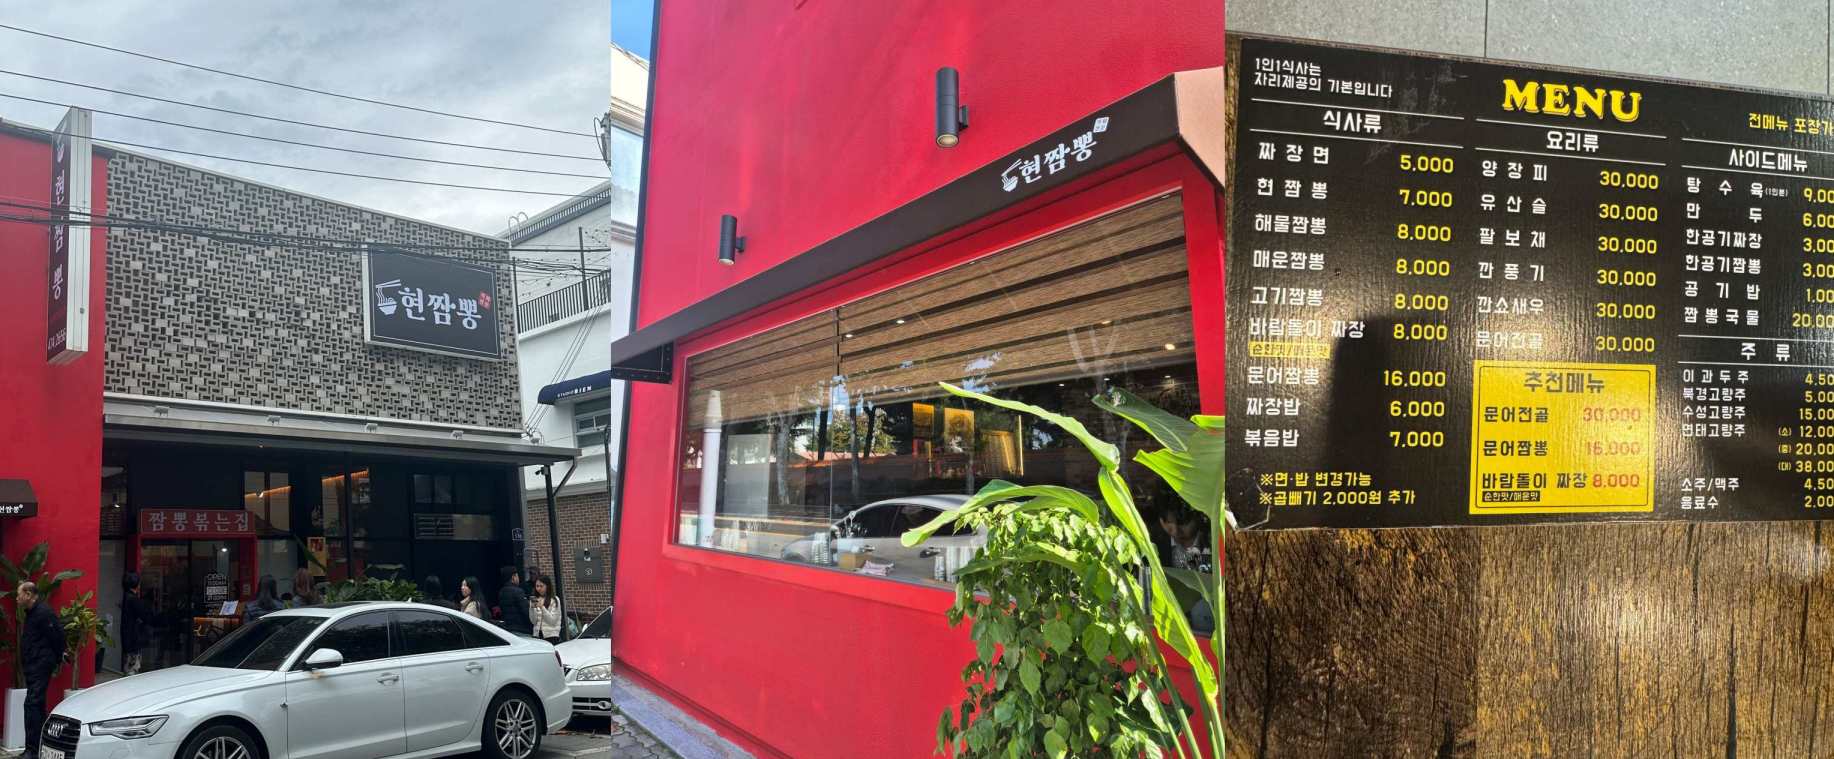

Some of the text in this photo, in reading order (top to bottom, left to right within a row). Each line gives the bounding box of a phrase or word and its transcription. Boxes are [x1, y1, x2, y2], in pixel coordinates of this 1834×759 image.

[1255, 58, 1321, 76] 1인1식사는
[1254, 72, 1392, 98] 자리제공의 기본입니다
[1502, 79, 1642, 122] MENU
[1323, 110, 1382, 133] 식사류
[1749, 113, 1788, 131] 전메뉴
[1547, 130, 1599, 152] 요리류
[1019, 131, 1097, 184] 현짬뽕
[1729, 149, 1807, 172] 사이드메뉴
[1255, 214, 1326, 235] 해물짬뽕
[1686, 228, 1762, 249] 한공기짜장
[1253, 250, 1325, 271] 매운짬뽕
[1685, 255, 1761, 274] 한공기짬뽕
[1251, 286, 1323, 306] 고기짬뽕
[398, 287, 482, 330] 현짬뽕
[1477, 296, 1544, 315] 깐소새우
[1250, 318, 1321, 336] 바람돌이
[1331, 320, 1365, 338] 짜장
[1247, 367, 1319, 385] 문어짬뽕
[1524, 371, 1604, 393] 추천메뉴
[1683, 388, 1746, 401] 북경고량주
[1246, 398, 1301, 416] 짜장밥
[1484, 406, 1549, 423] 문어전골
[1682, 406, 1745, 419] 수성고량주
[1244, 430, 1299, 447] 볶음밥
[1682, 424, 1745, 437] 연태고량주
[1483, 441, 1548, 456] 문어짬뽕
[1315, 472, 1372, 486] 변경가능
[1482, 473, 1546, 489] 바람돌이
[1557, 473, 1588, 488] 짜장
[1681, 478, 1740, 492] 소주/맥주
[1388, 490, 1415, 505] 추가
[1681, 496, 1718, 510] 음료수
